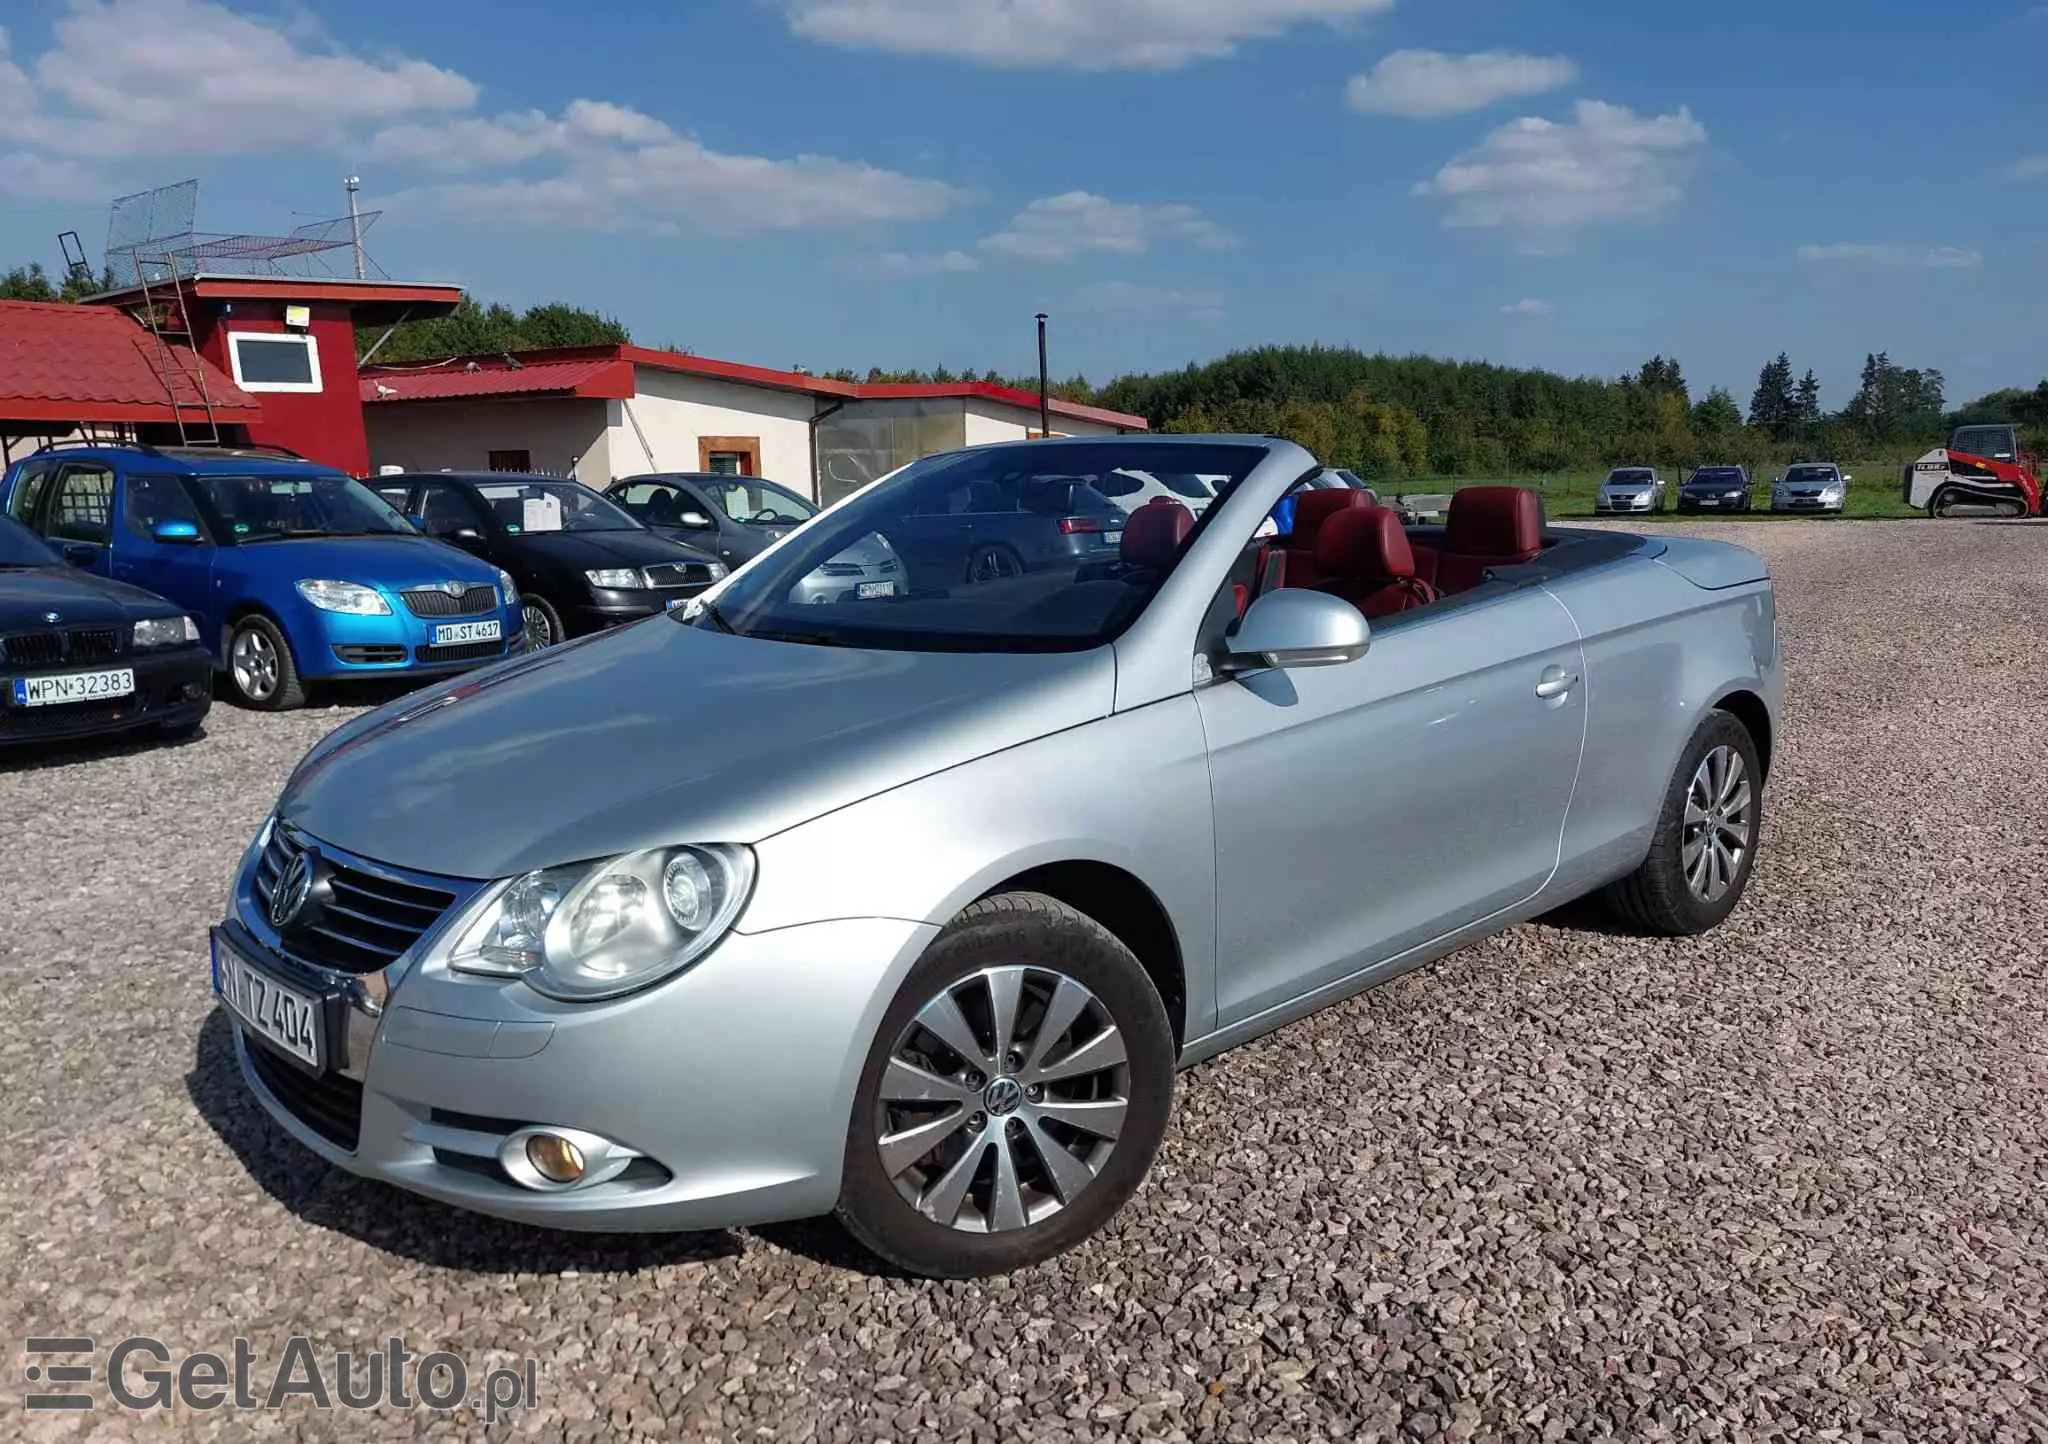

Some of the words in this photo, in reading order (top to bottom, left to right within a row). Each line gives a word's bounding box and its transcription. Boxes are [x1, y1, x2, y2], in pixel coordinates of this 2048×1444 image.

[438, 627, 453, 641] MD
[460, 625, 472, 639] ST
[475, 622, 498, 637] 4617
[28, 680, 69, 700] WPN
[75, 672, 132, 696] 32383
[243, 967, 272, 1033] TZ
[273, 988, 316, 1058] 404
